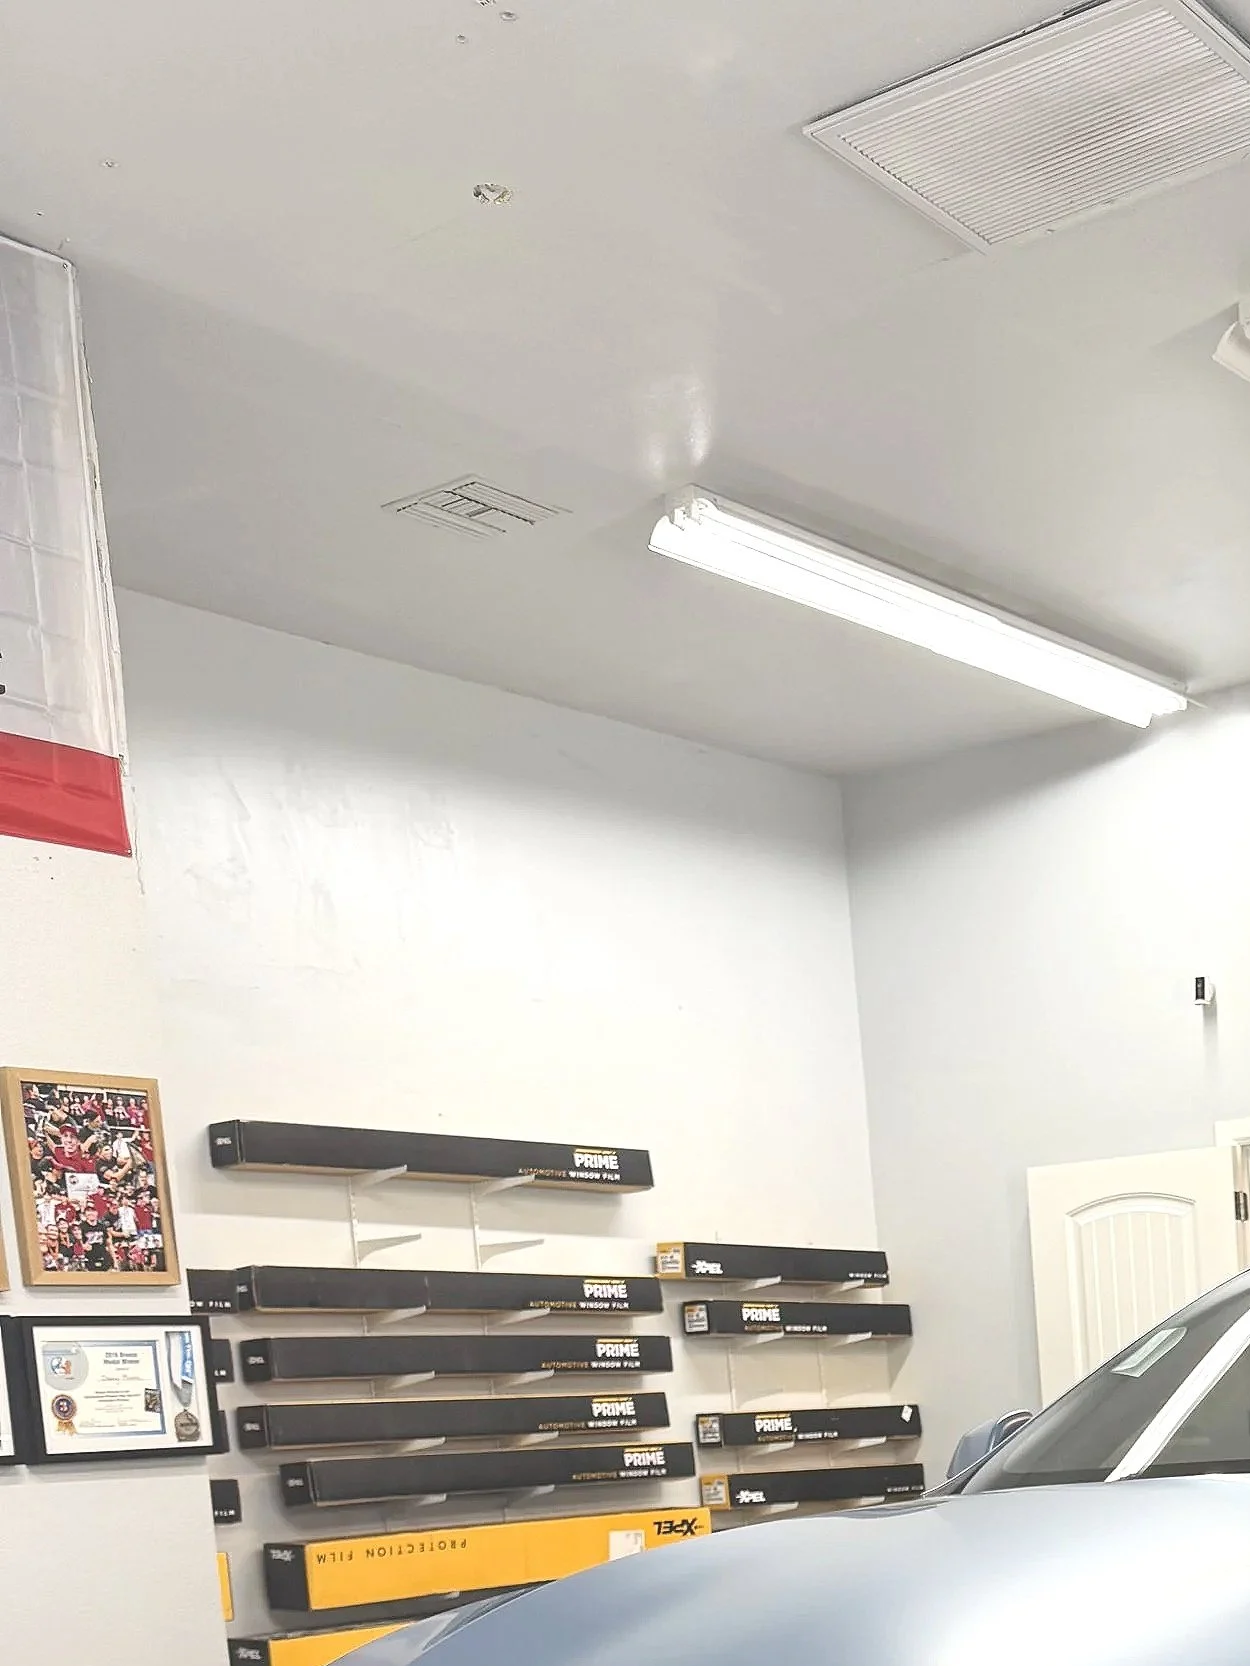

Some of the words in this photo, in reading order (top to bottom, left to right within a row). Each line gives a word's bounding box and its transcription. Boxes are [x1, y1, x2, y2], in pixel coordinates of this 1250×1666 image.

[575, 1153, 619, 1170] PRIME
[518, 1168, 567, 1178] AUTOMOTIVE
[568, 1170, 600, 1179] WINDOW
[602, 1173, 621, 1181] FILM
[691, 1259, 723, 1275] XPEL
[584, 1284, 628, 1299] PRIME
[529, 1301, 577, 1309] AUTOMOTIVE
[579, 1301, 610, 1309] WINDOW
[612, 1301, 629, 1309] FILM
[742, 1307, 781, 1322] PRIME
[596, 1343, 640, 1358] PRIME
[540, 1361, 589, 1369] AUTOMOTIVE
[590, 1361, 621, 1369] WINDOW
[592, 1401, 636, 1417] PRIME
[587, 1420, 618, 1428] WINDOW
[620, 1418, 637, 1426] FILM
[755, 1418, 793, 1433] PRIME
[623, 1451, 665, 1467] PRIME
[736, 1489, 767, 1503] XPEL
[653, 1517, 703, 1536] XPEL
[366, 1538, 467, 1560] PROTECTION
[316, 1550, 354, 1565] FILM
